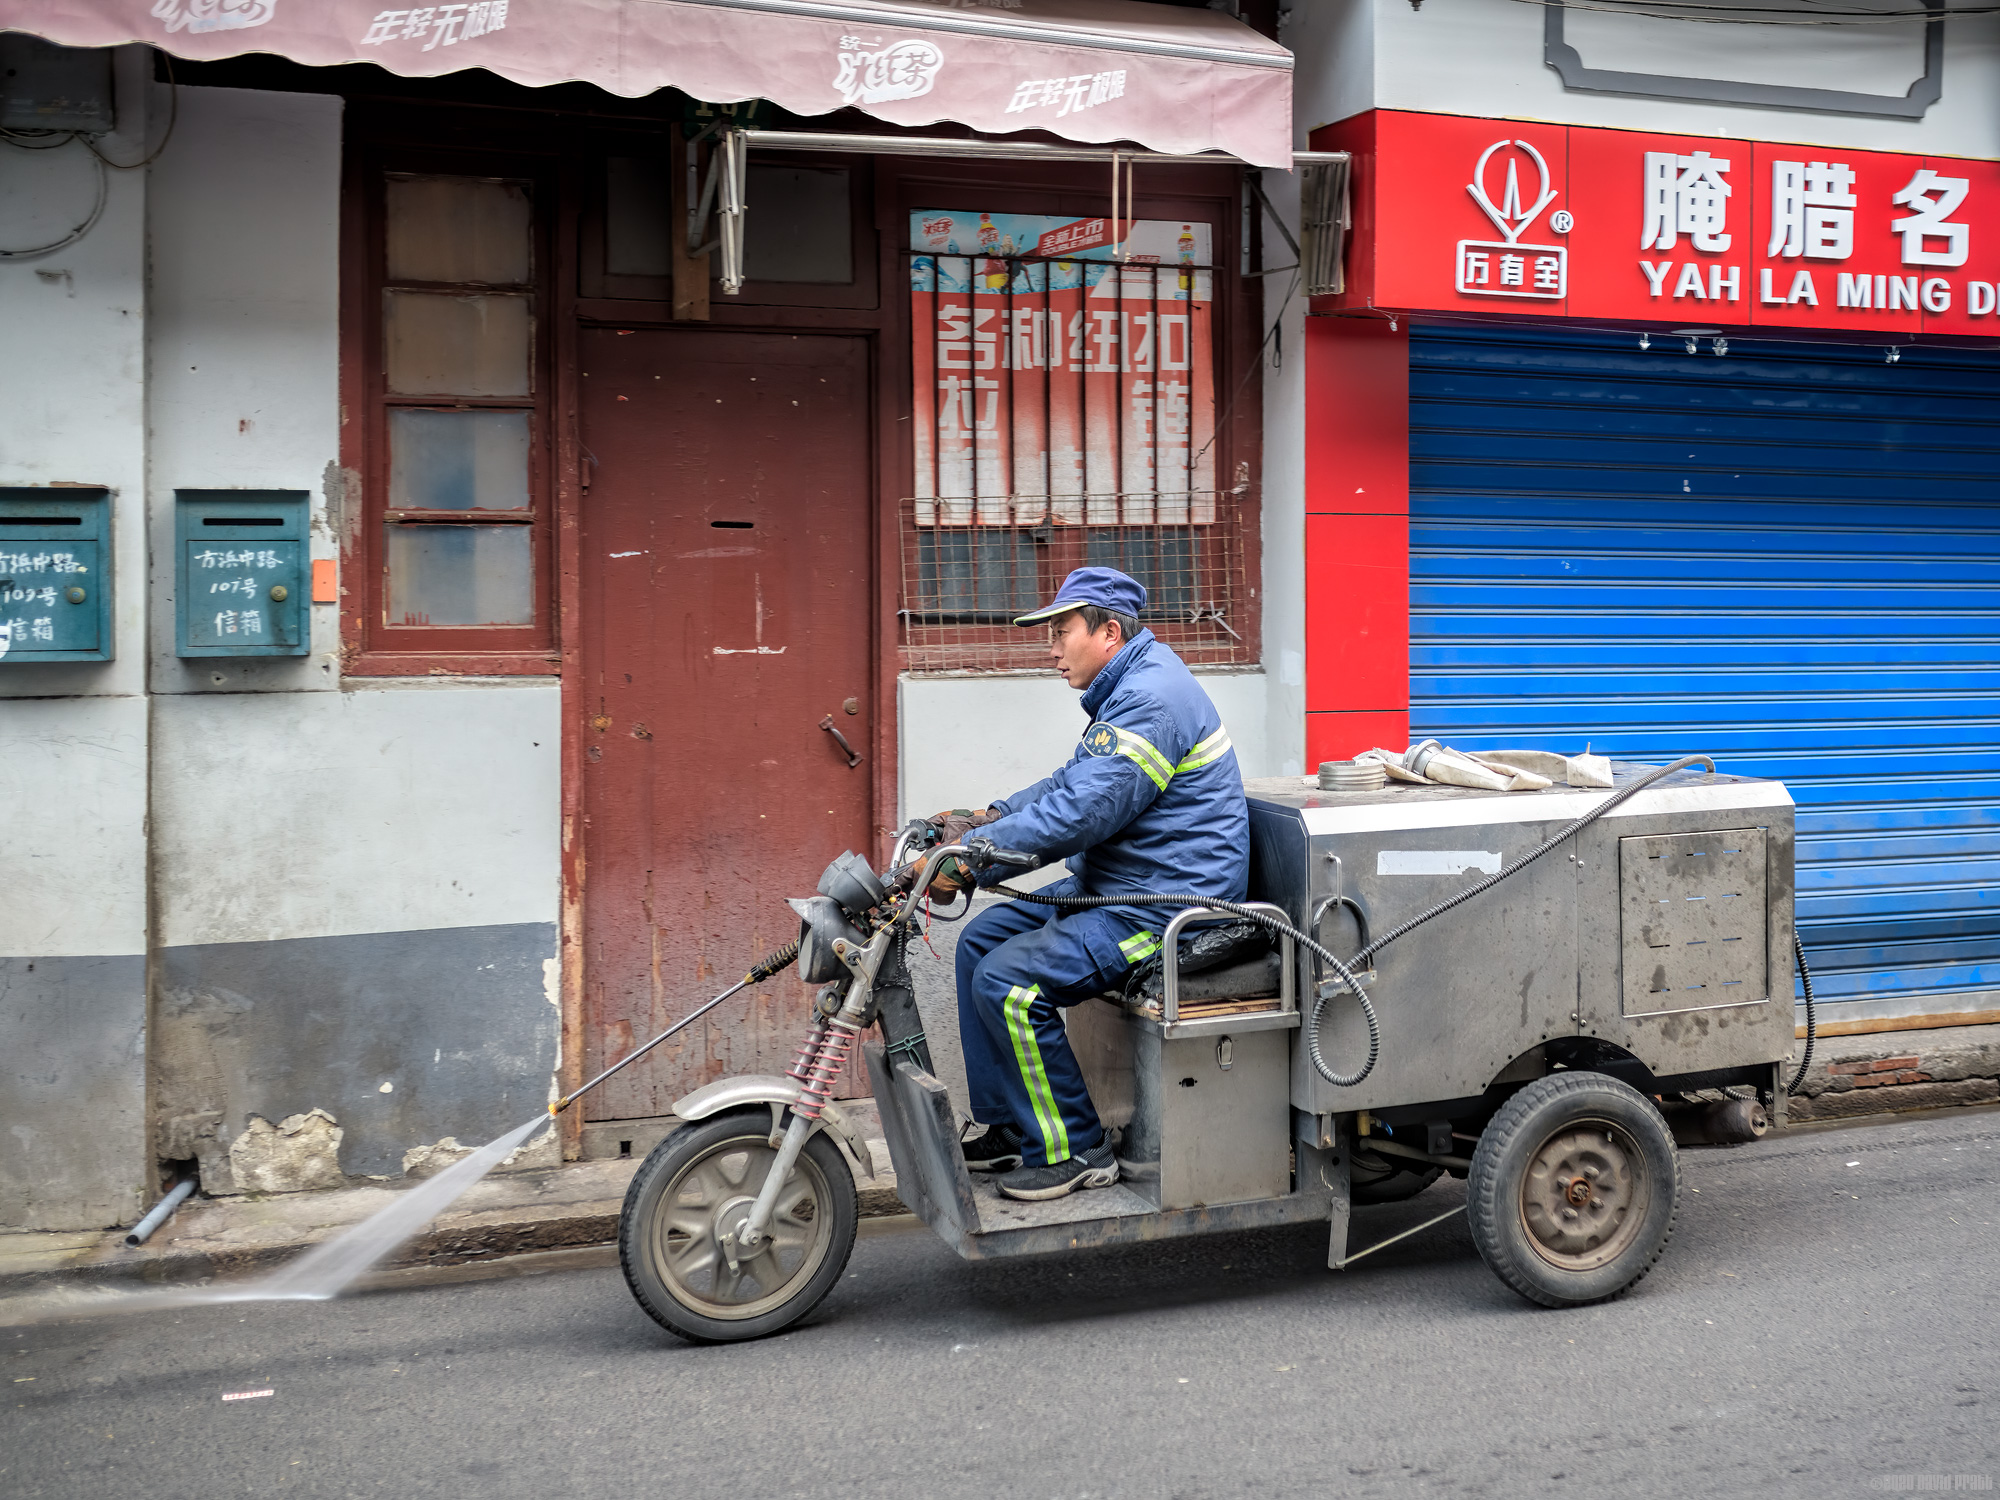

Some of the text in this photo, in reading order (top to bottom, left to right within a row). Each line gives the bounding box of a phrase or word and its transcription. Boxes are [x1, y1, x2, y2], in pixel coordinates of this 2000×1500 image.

[360, 0, 509, 52] 年轻无极限
[839, 35, 880, 51] 统一
[834, 40, 943, 102] 冰红茶
[1004, 70, 1127, 118] 年轻无极限
[1641, 151, 1970, 267] 腌腊名
[1042, 218, 1105, 249] 全新上市
[1464, 251, 1560, 289] 万有全
[1639, 260, 2000, 316] YAH LA MING D
[937, 303, 1190, 373] 各种纽扣
[4, 586, 58, 607] 109号
[209, 577, 258, 599] 107号
[7, 616, 54, 641] 信箱
[213, 609, 262, 637] 信箱
